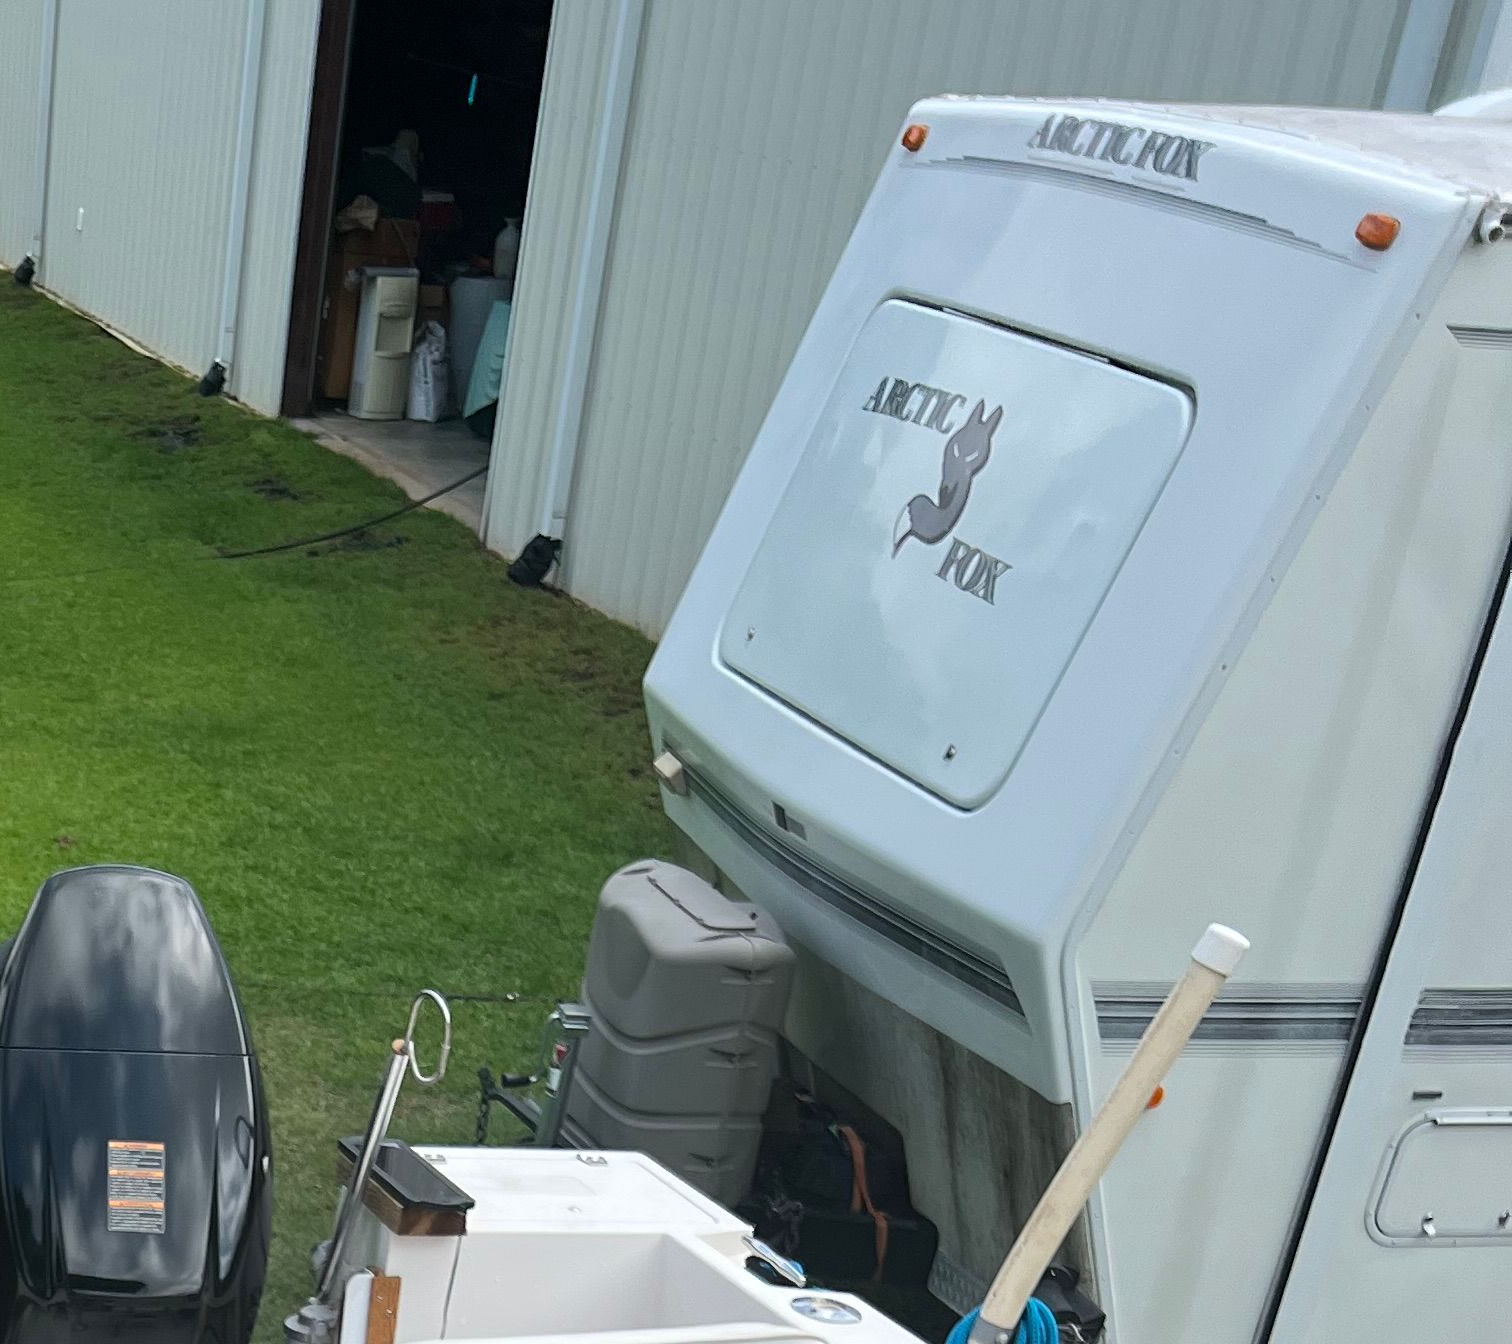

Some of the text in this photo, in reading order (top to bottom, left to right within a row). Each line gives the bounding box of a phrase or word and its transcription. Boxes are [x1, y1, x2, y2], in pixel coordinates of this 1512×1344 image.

[1028, 112, 1217, 182] ARCTIC FOX
[862, 375, 968, 434] ARCTIC
[935, 535, 1013, 606] FOX
